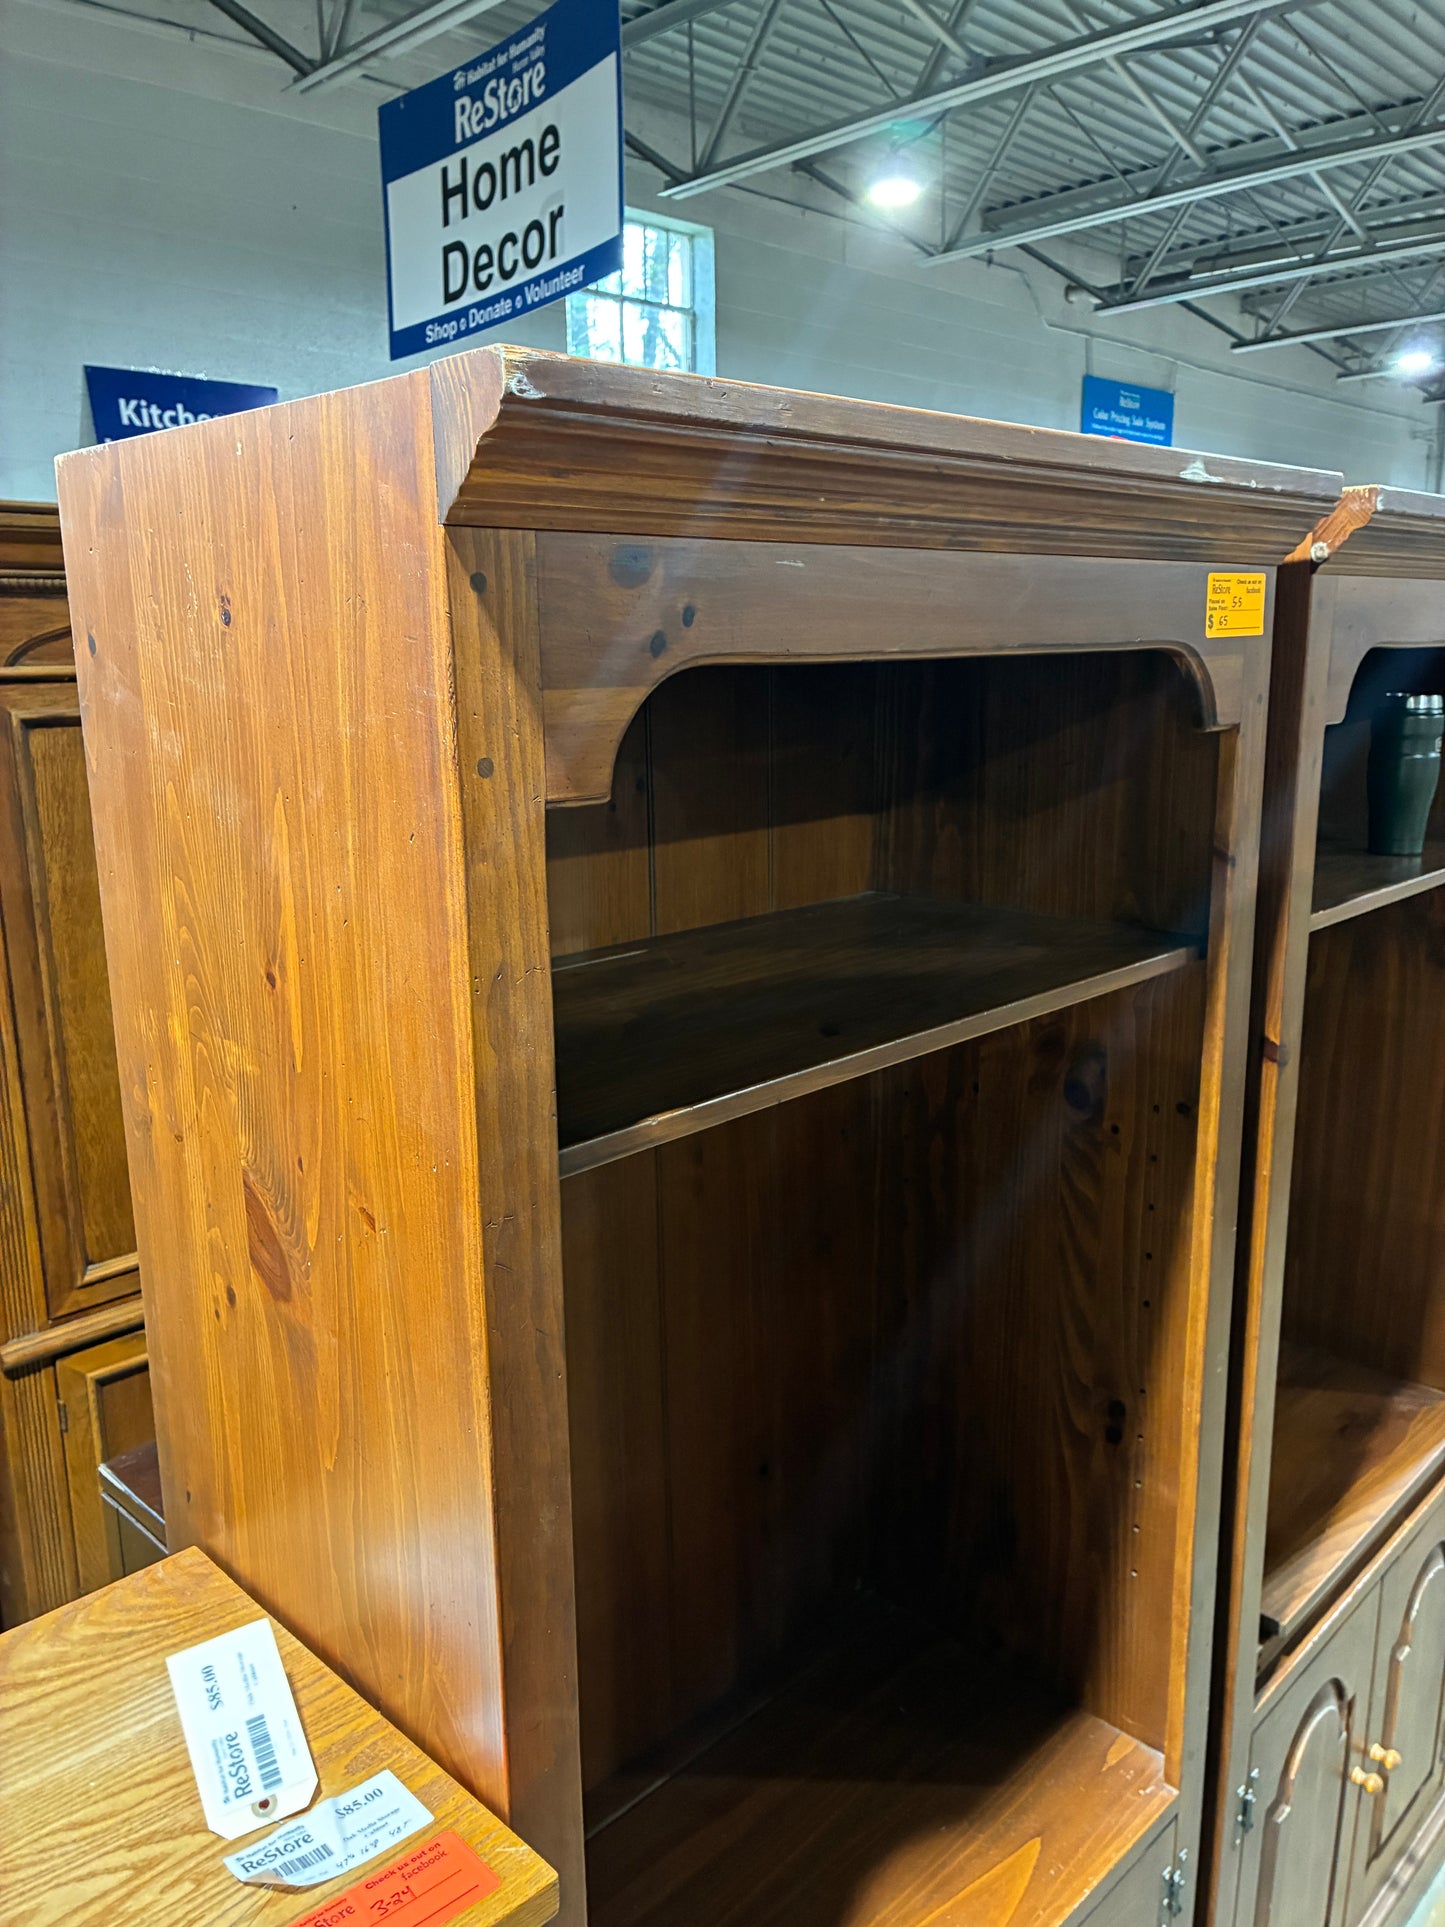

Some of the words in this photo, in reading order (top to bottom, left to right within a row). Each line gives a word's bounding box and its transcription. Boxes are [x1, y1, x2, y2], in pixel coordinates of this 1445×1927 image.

[454, 61, 546, 144] ReStore
[441, 124, 560, 228] Home
[442, 204, 564, 306] Decor
[425, 319, 458, 343] Shop
[468, 297, 513, 329] Donate
[524, 264, 586, 305] Volunteer
[118, 397, 224, 429] Kitche
[1207, 613, 1214, 630] $
[201, 1664, 223, 1711] $85.00
[225, 1731, 253, 1799] ReStore
[335, 1787, 383, 1819] $85.00
[240, 1831, 314, 1874] ReStore
[365, 1869, 397, 1890] Check
[397, 1861, 410, 1872] us
[410, 1849, 428, 1863] out
[428, 1841, 442, 1853] on
[401, 1850, 448, 1881] facebook
[313, 1905, 356, 1927] Store
